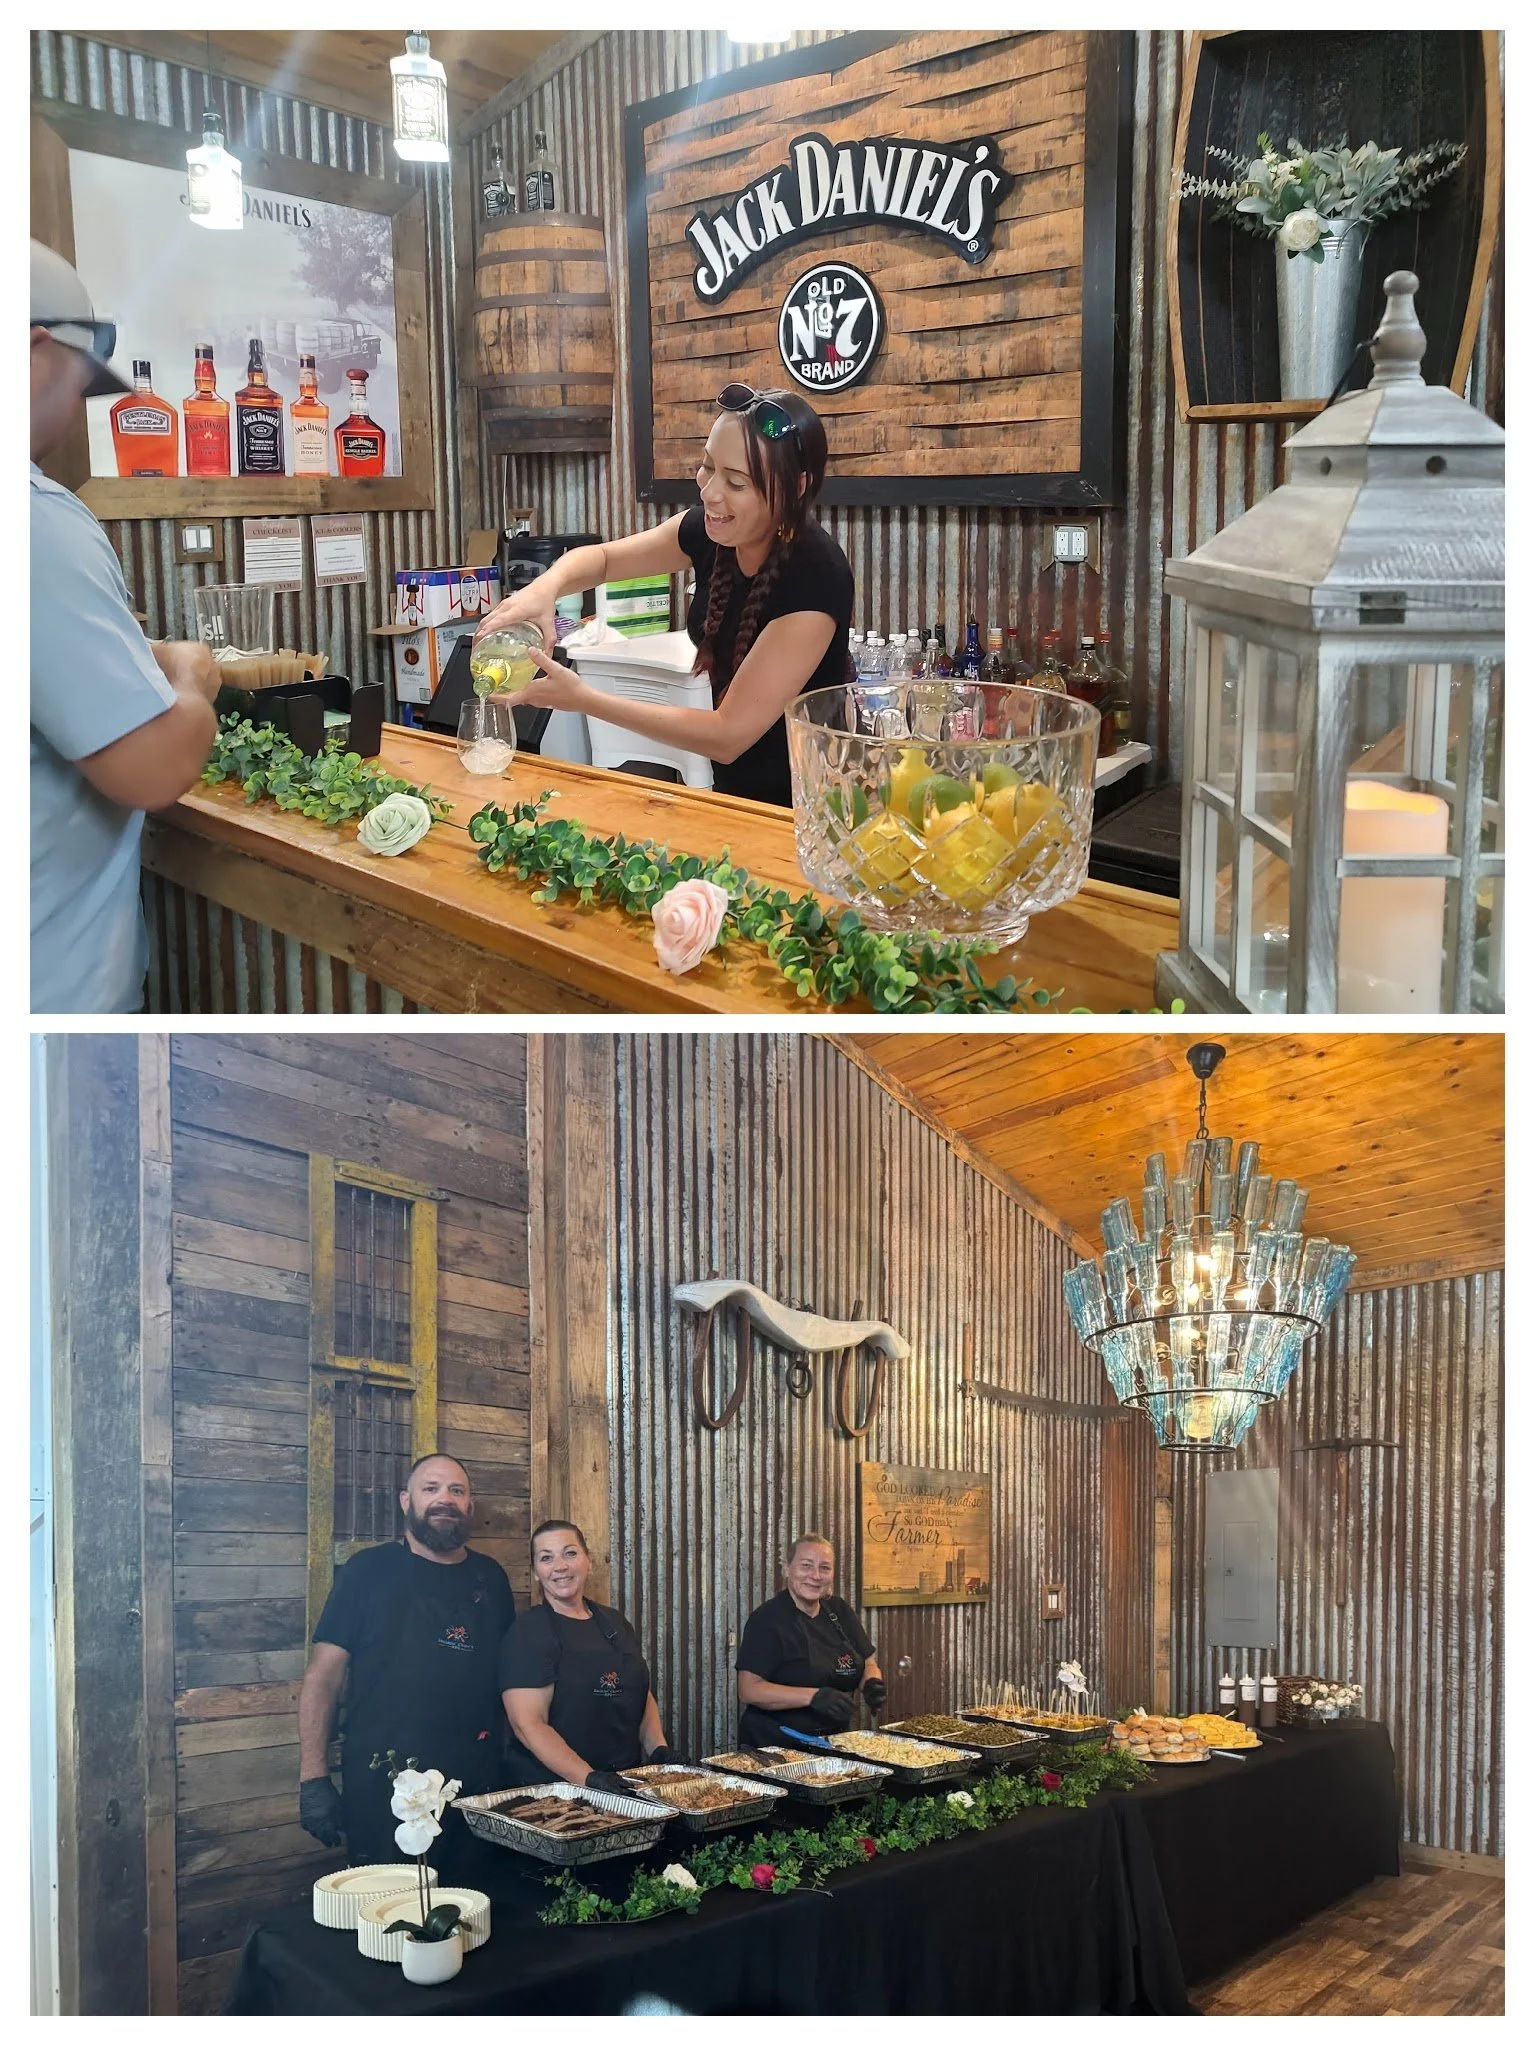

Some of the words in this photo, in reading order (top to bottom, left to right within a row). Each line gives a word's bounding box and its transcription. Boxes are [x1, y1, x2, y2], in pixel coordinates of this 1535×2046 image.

[689, 171, 796, 296] JACK
[793, 140, 1000, 241] DANIEL'S
[807, 276, 845, 297] OLD
[801, 359, 855, 382] BRAND
[242, 414, 258, 426] JACK
[294, 424, 308, 436] JACK
[252, 527, 293, 535] CHECKLIST
[401, 635, 421, 645] Tito's
[876, 1482, 897, 1493] GOD
[900, 1484, 936, 1496] LOOKED
[936, 1485, 981, 1508] Paradise
[903, 1515, 914, 1526] So
[915, 1515, 935, 1527] GOD
[867, 1510, 943, 1548] Farmer
